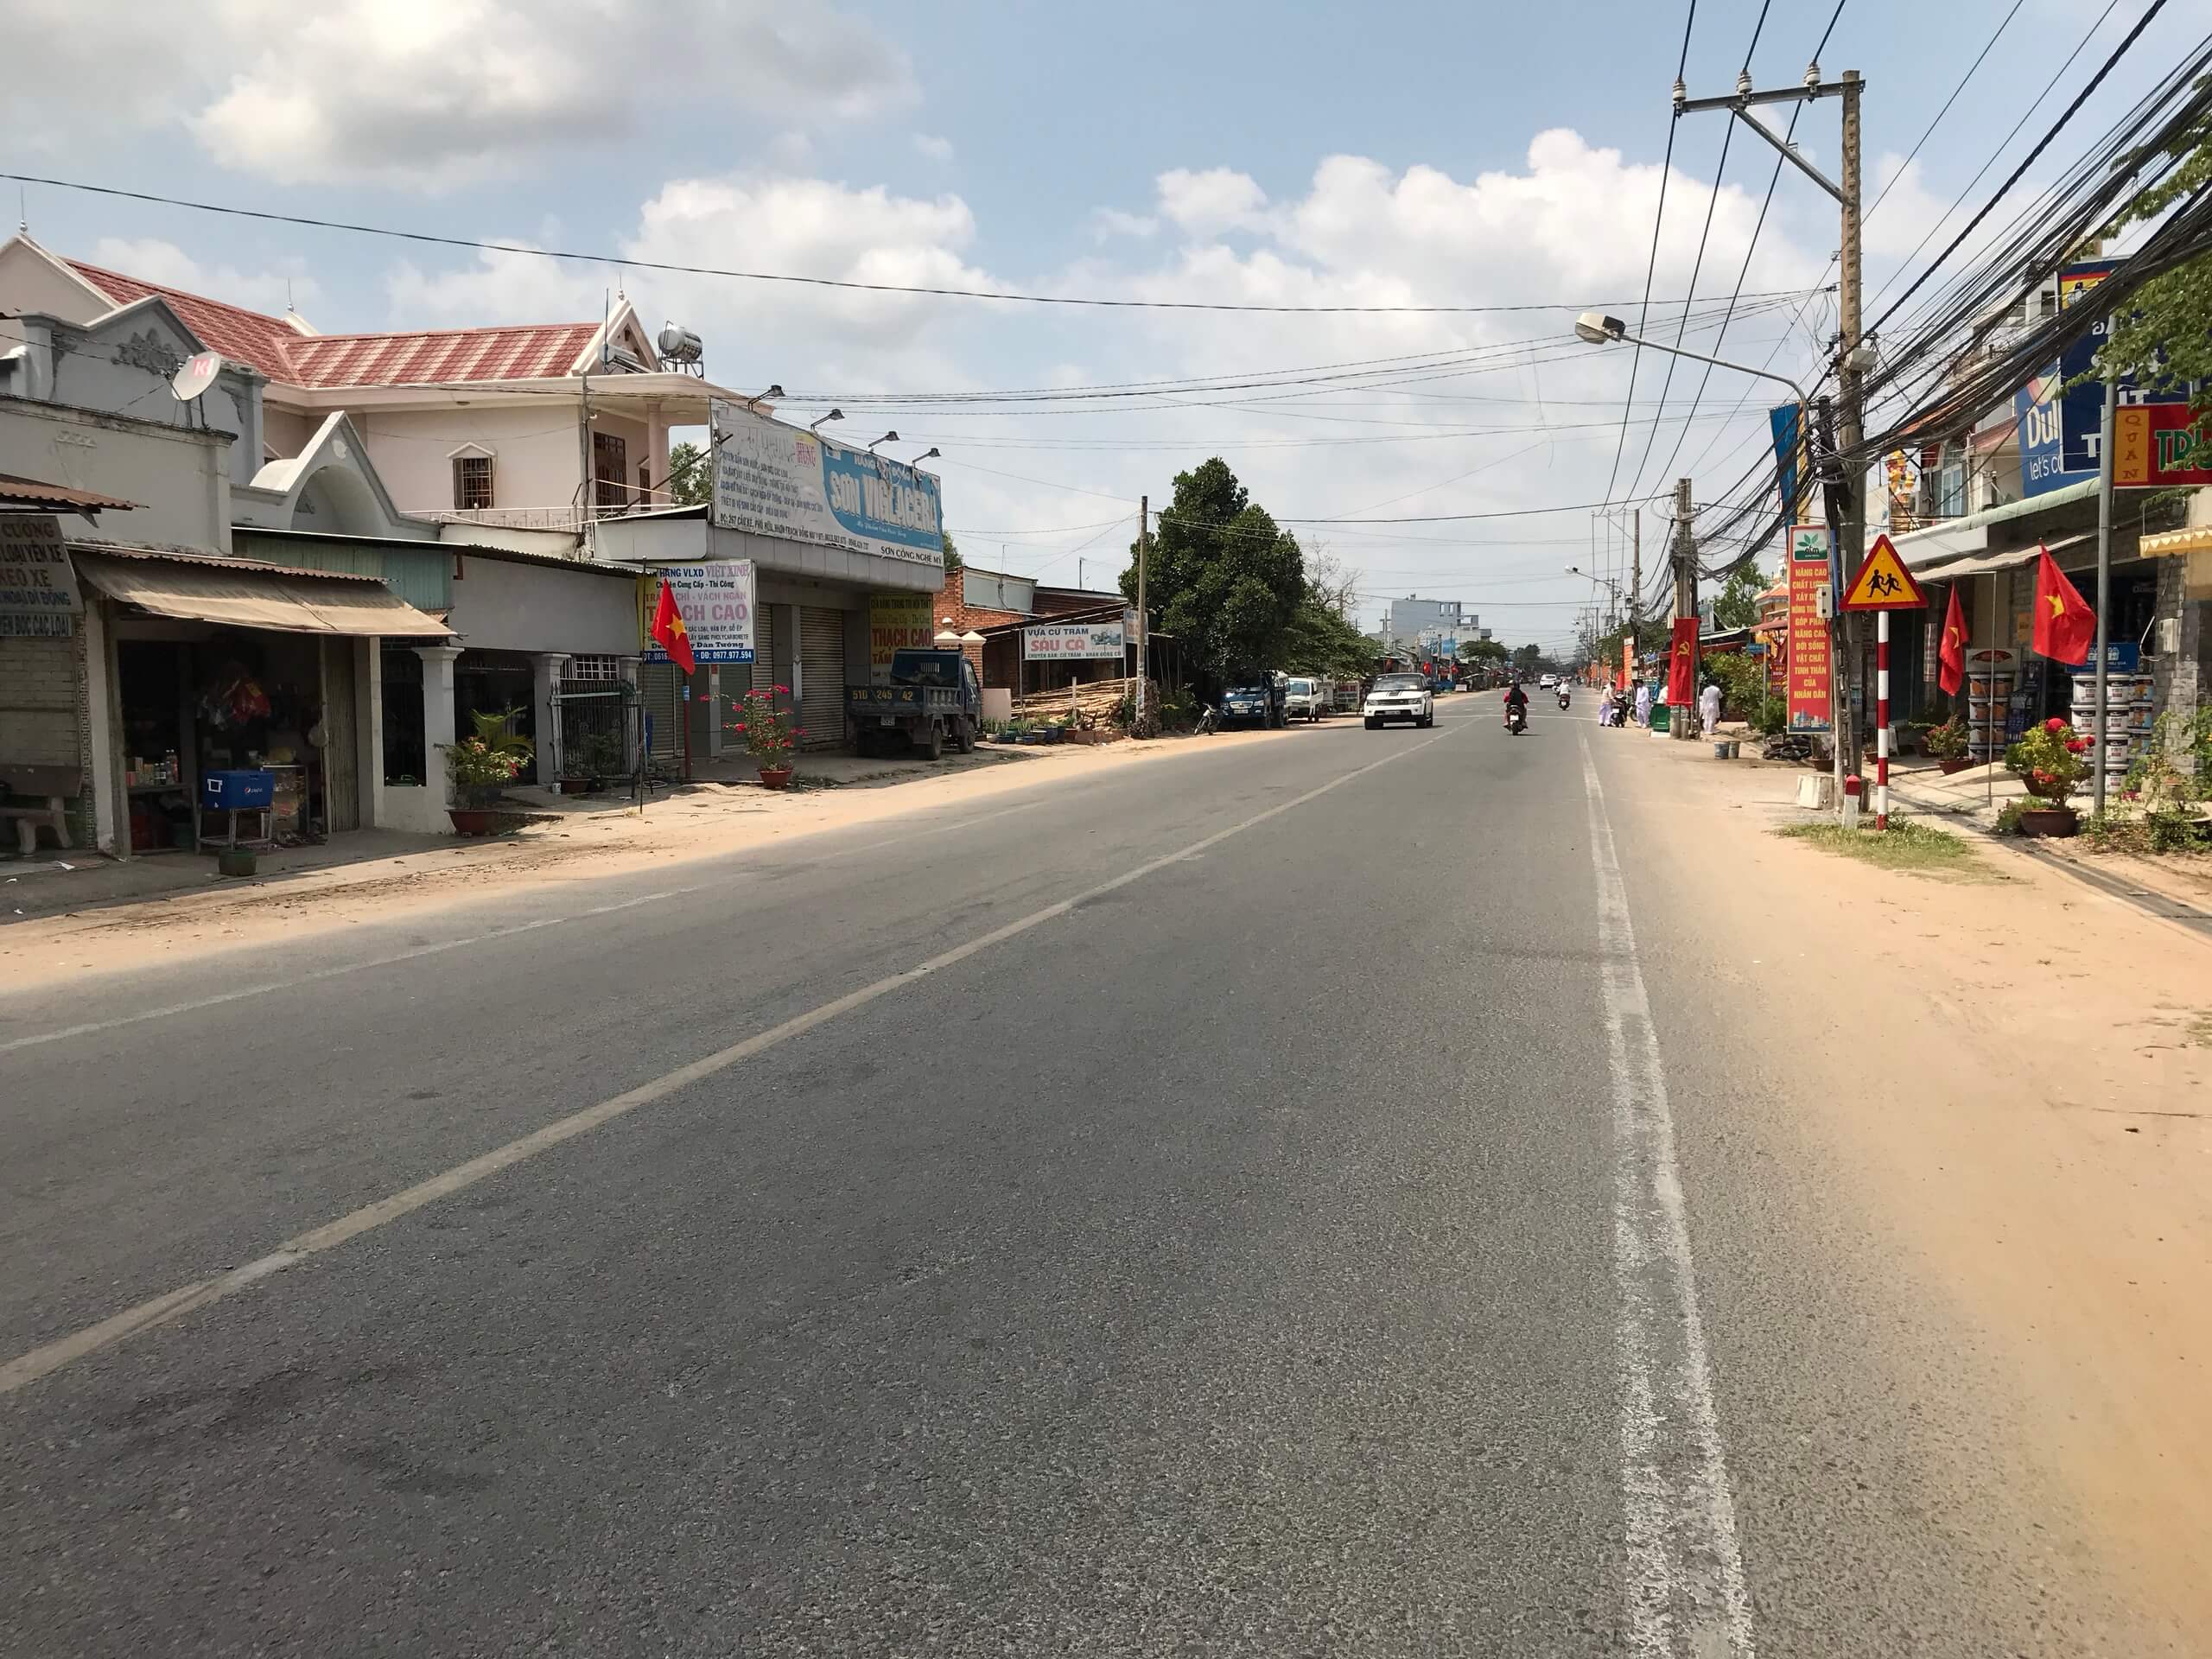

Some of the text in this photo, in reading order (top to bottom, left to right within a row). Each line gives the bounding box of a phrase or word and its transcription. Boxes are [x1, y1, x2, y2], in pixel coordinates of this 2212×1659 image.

[2026, 400, 2060, 449] Dul
[2030, 455, 2050, 480] let's
[896, 548, 915, 560] CÔNG
[683, 569, 703, 577] VLXD
[693, 580, 704, 589] Cấp
[720, 580, 734, 588] Công
[712, 603, 747, 621] CAO
[872, 628, 931, 650] THẠCH CAO
[713, 651, 752, 659] 0977.977.594
[902, 690, 913, 701] 42
